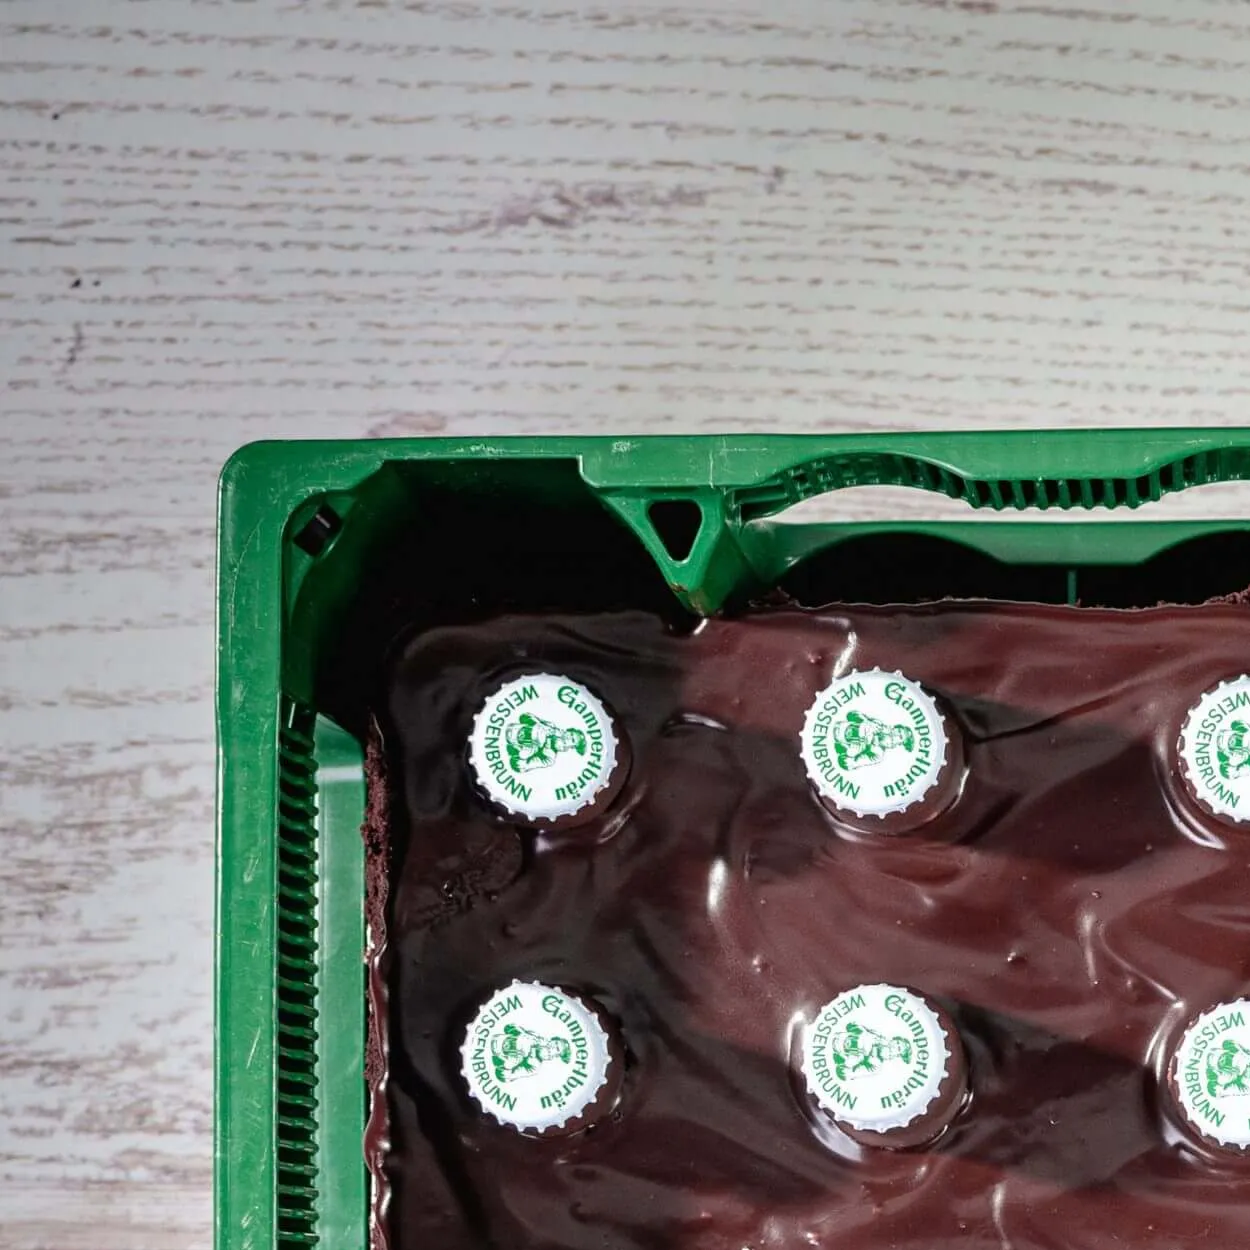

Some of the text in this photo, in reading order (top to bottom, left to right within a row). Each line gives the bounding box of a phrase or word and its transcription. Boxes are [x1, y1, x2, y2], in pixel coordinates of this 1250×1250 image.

[484, 684, 539, 801] WEISSENBRUNN
[555, 686, 604, 800] Gampertbräu
[812, 682, 864, 800] WEISSENBRUNN
[883, 682, 932, 798] Gampertbräu
[1195, 692, 1250, 808] WEISSENBRUNN
[471, 995, 521, 1111] WEISSENBRUNN
[540, 995, 588, 1109] Gampertbräu
[813, 995, 865, 1110] WEISSENBRUNN
[881, 995, 929, 1107] Gampertbräu
[1185, 1012, 1245, 1127] WEISSENBRUNN
